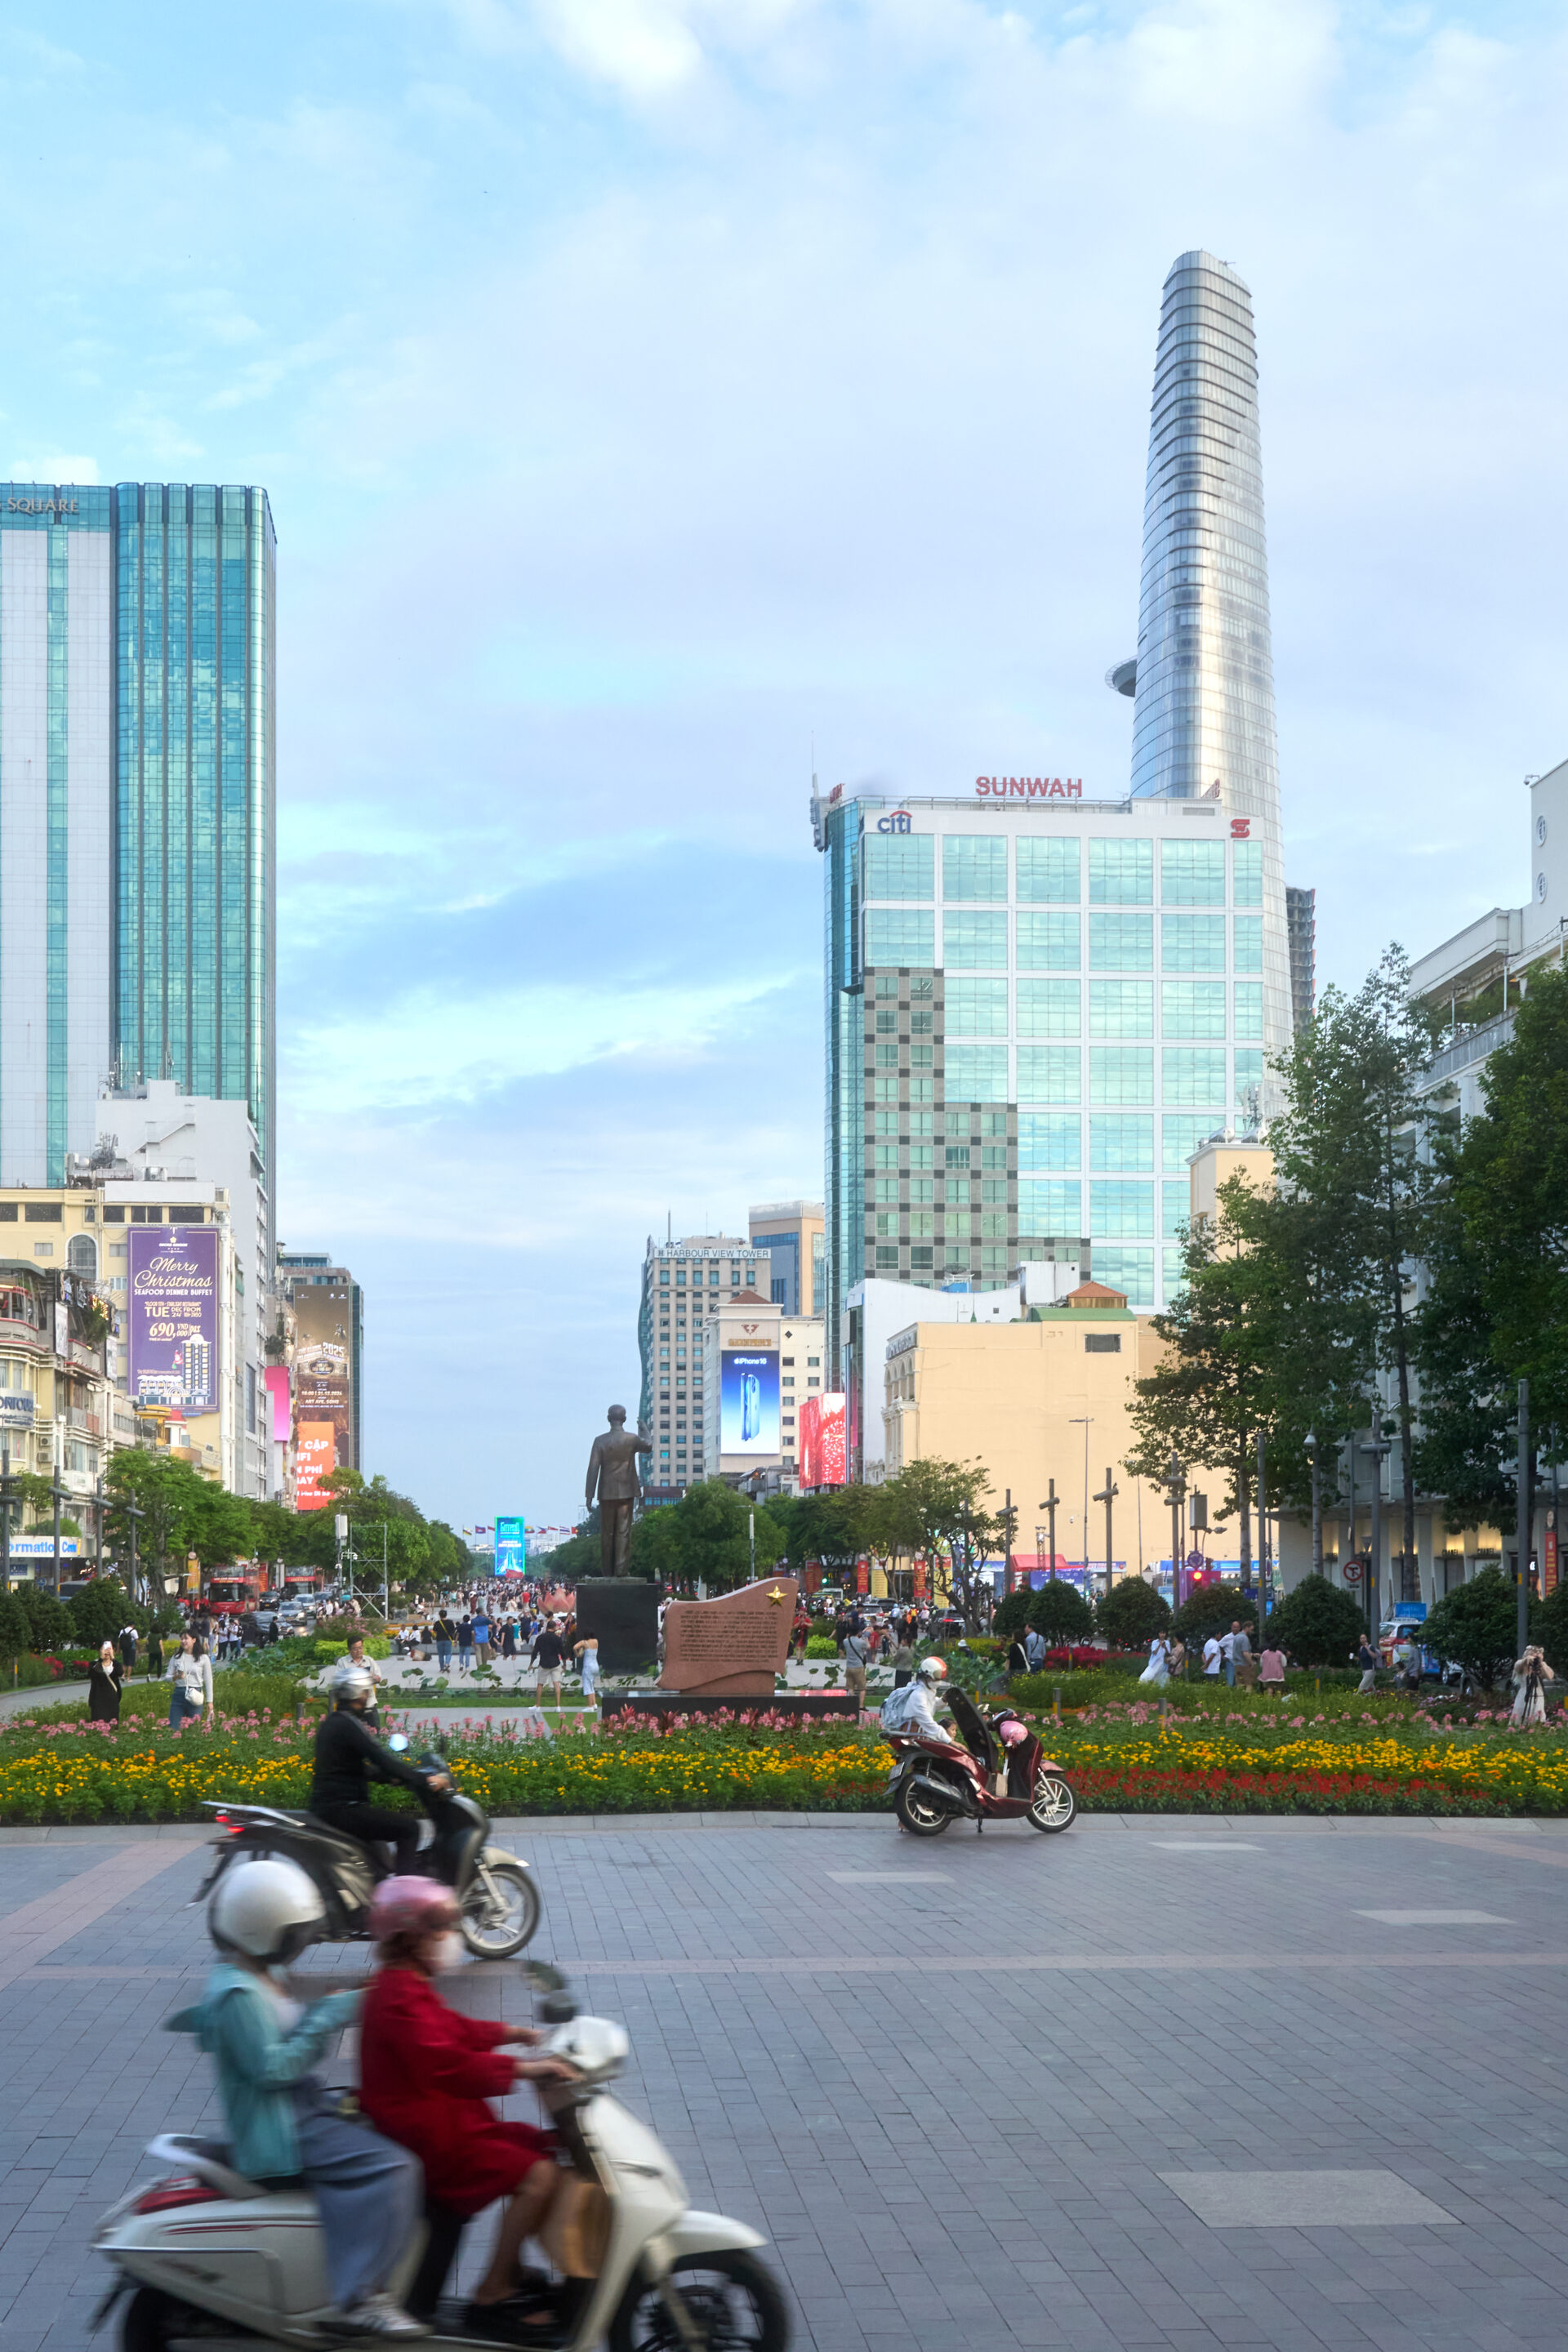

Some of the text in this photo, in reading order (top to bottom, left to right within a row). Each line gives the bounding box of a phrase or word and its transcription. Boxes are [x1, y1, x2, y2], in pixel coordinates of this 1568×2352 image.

[7, 497, 79, 513] SQUARE
[976, 777, 1082, 798] SUNWAH
[877, 812, 911, 833] citi
[666, 1249, 709, 1258] HARBOUR
[712, 1250, 734, 1258] VIEW
[737, 1250, 768, 1258] TOWER
[149, 1257, 198, 1275] Merry
[134, 1270, 213, 1289] Christmas
[145, 1306, 170, 1317] TUE
[323, 1342, 345, 1357] 2025
[305, 1439, 329, 1452] CẬP
[297, 1453, 311, 1461] IFI
[305, 1463, 323, 1473] PHÍ
